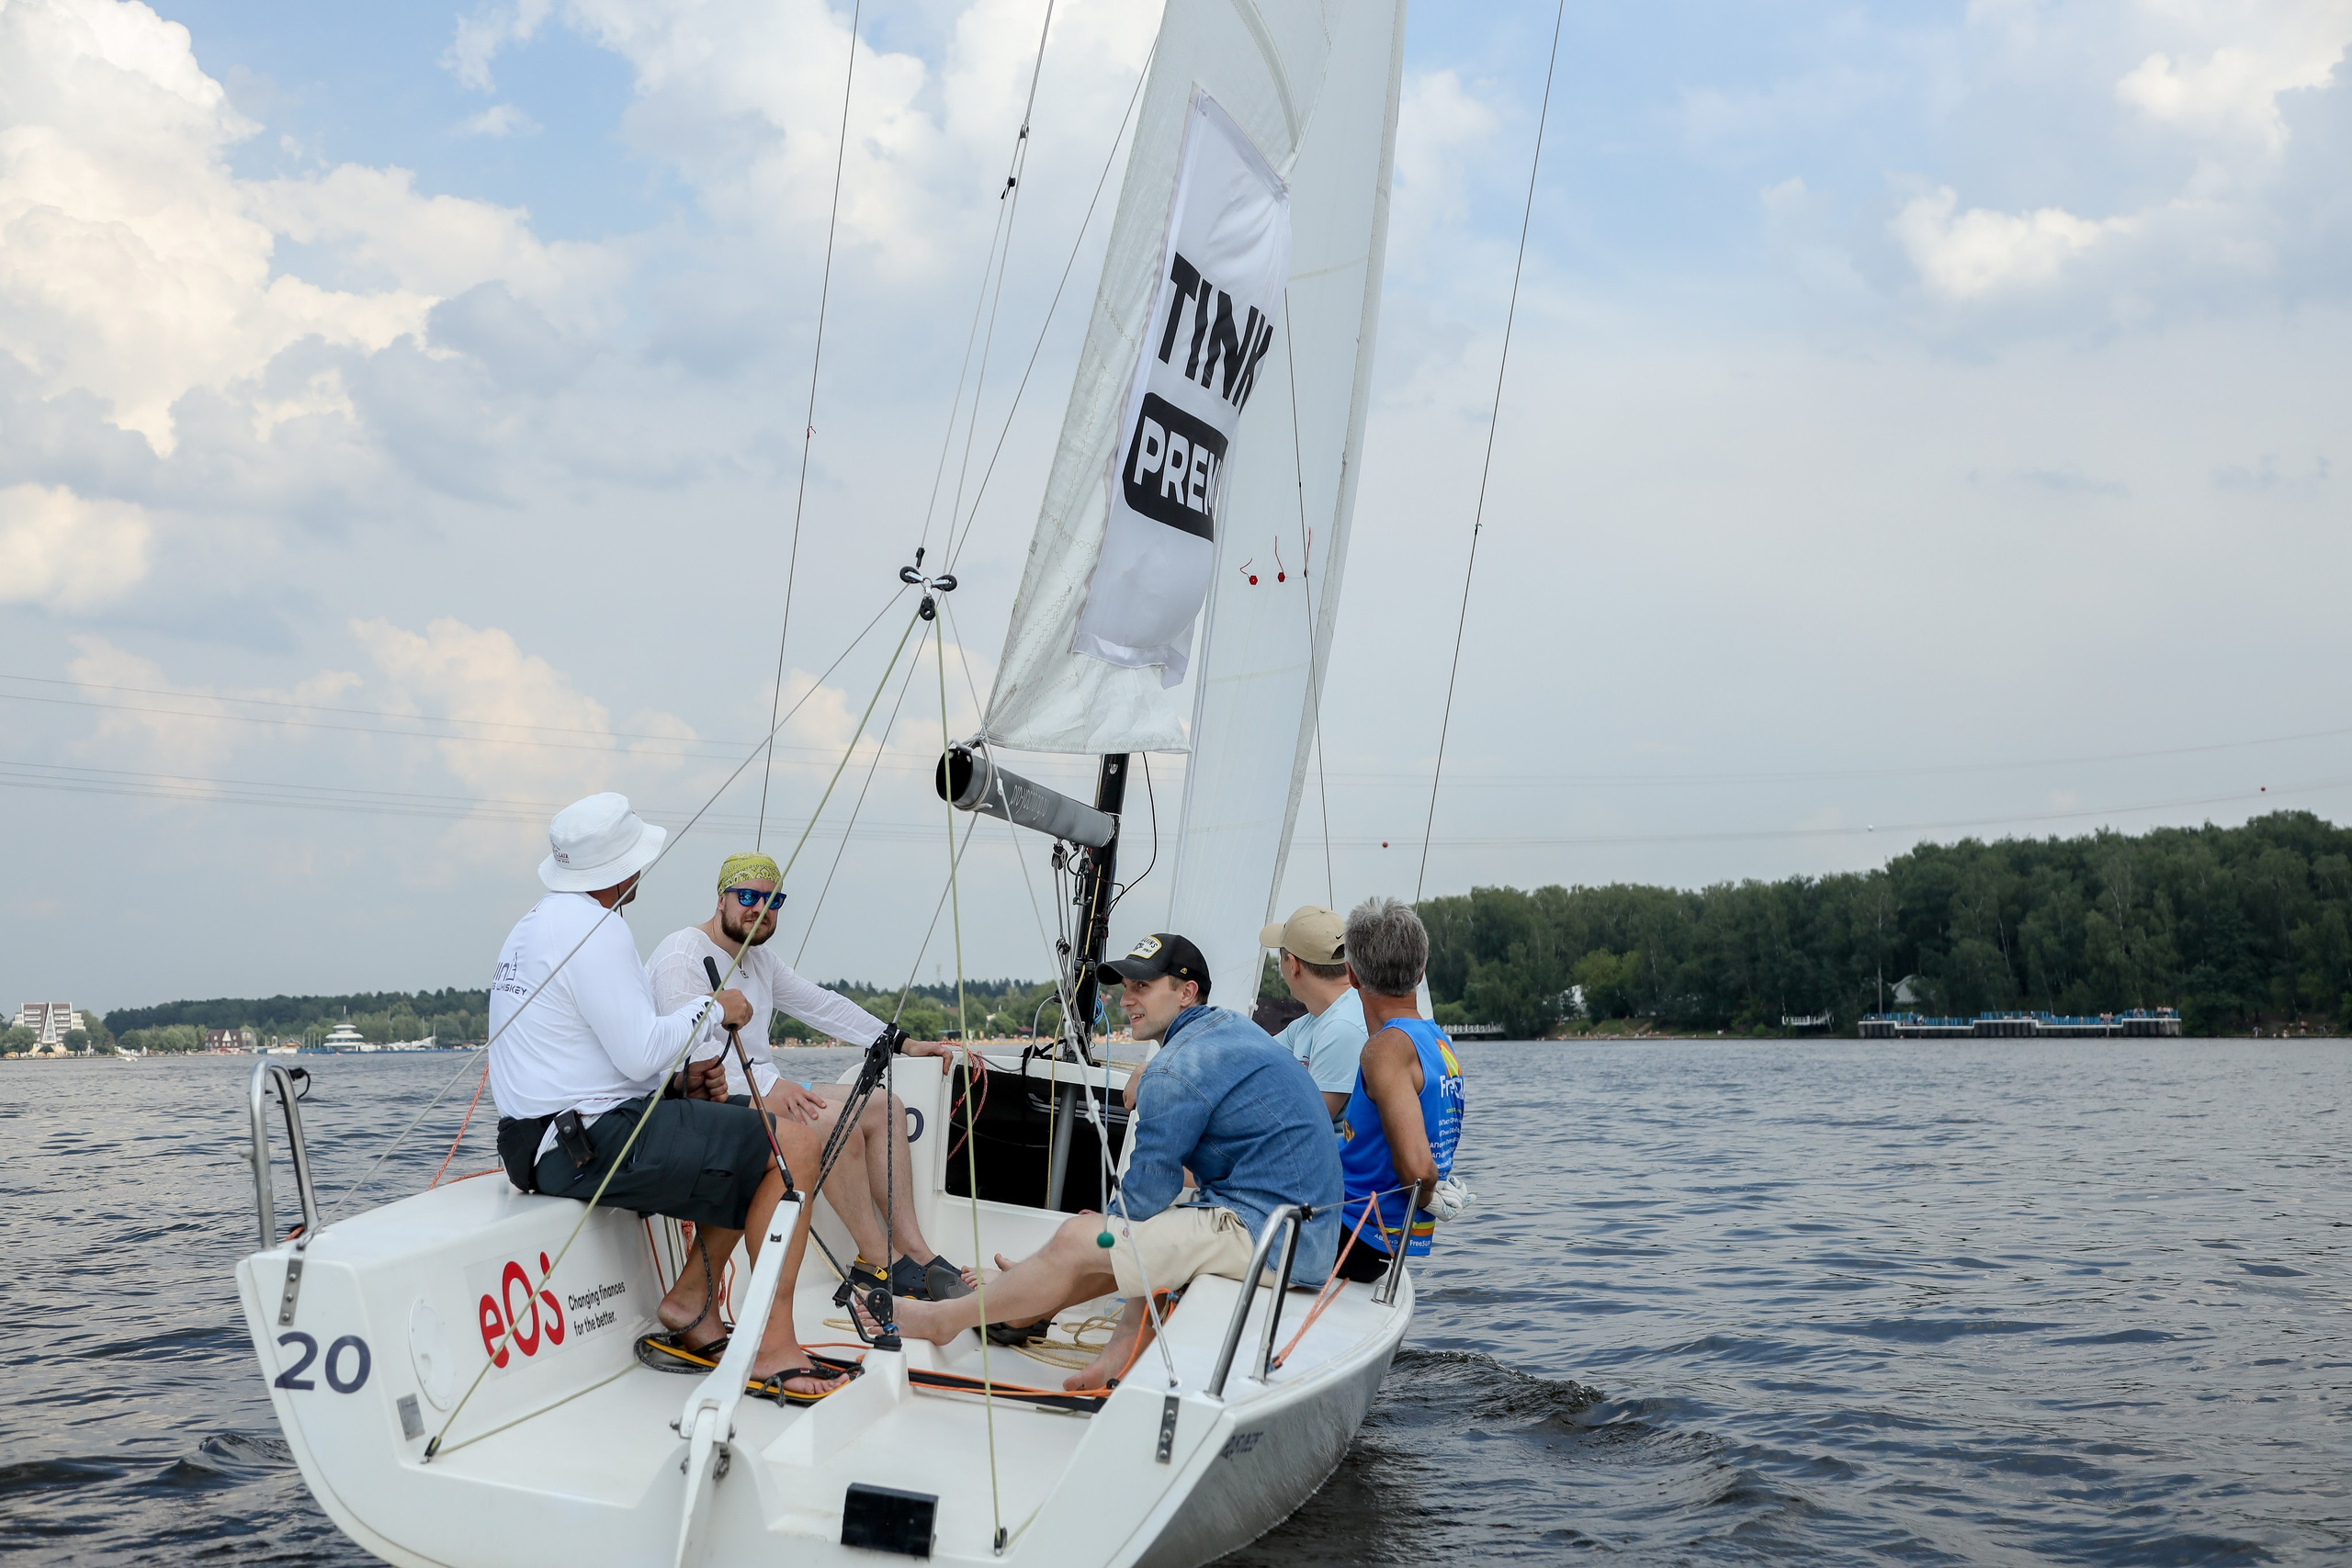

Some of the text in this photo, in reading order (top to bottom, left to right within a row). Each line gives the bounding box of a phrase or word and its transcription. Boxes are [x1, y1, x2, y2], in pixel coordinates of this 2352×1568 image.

[568, 1280, 626, 1312] Changing finances
[573, 1310, 617, 1337] for the better.
[274, 1330, 372, 1394] 20
